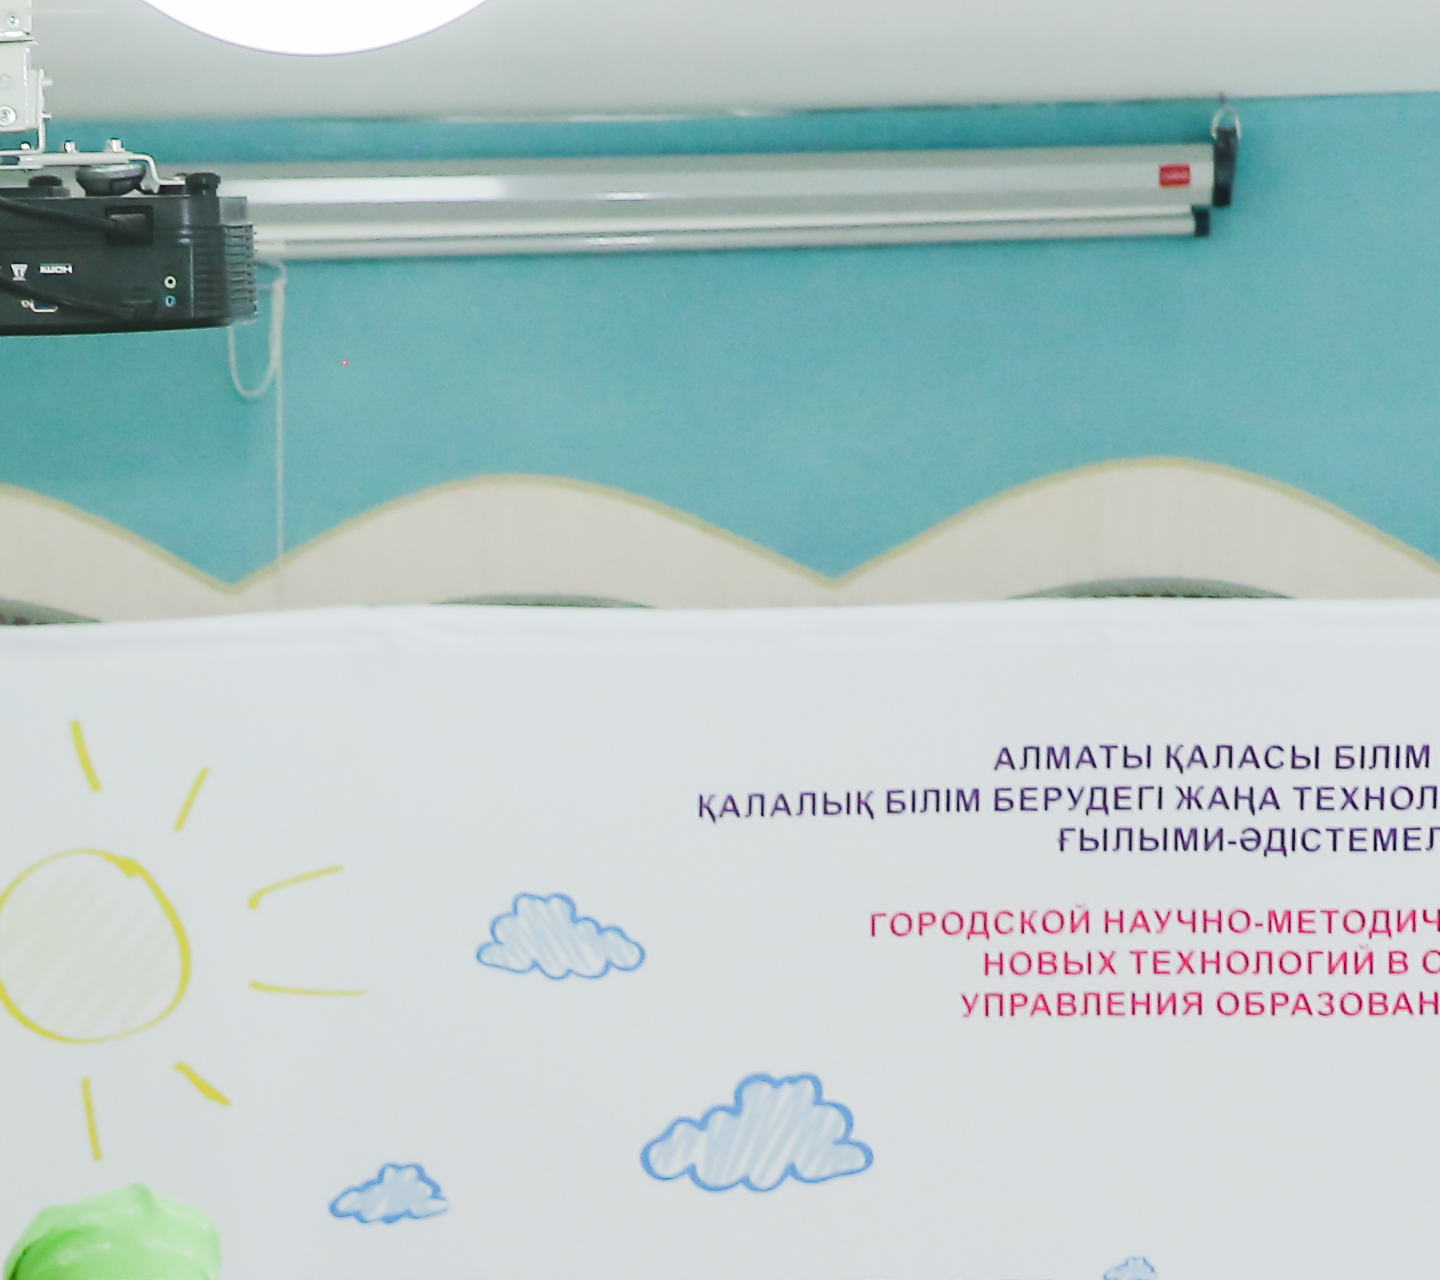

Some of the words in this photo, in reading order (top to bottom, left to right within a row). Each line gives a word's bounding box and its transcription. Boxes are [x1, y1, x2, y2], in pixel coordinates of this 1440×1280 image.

[994, 745, 1151, 770] АЛМАТЫ
[1166, 744, 1319, 774] ҚАЛАСЫ
[1335, 744, 1430, 770] БІЛІМ
[699, 791, 874, 824] ҚАЛАЛЫҚ
[886, 788, 980, 814] БІЛІМ
[994, 786, 1163, 816] БЕРУДЕГІ
[1175, 786, 1280, 816] ЖАҢА
[871, 905, 1090, 940] ГОРОДСКОЙ
[984, 951, 1116, 976] НОВЫХ
[1129, 946, 1374, 975] ТЕХНОЛОГИЙ
[1388, 950, 1408, 975] В
[961, 992, 1202, 1017] УПРАВЛЕНИЯ
